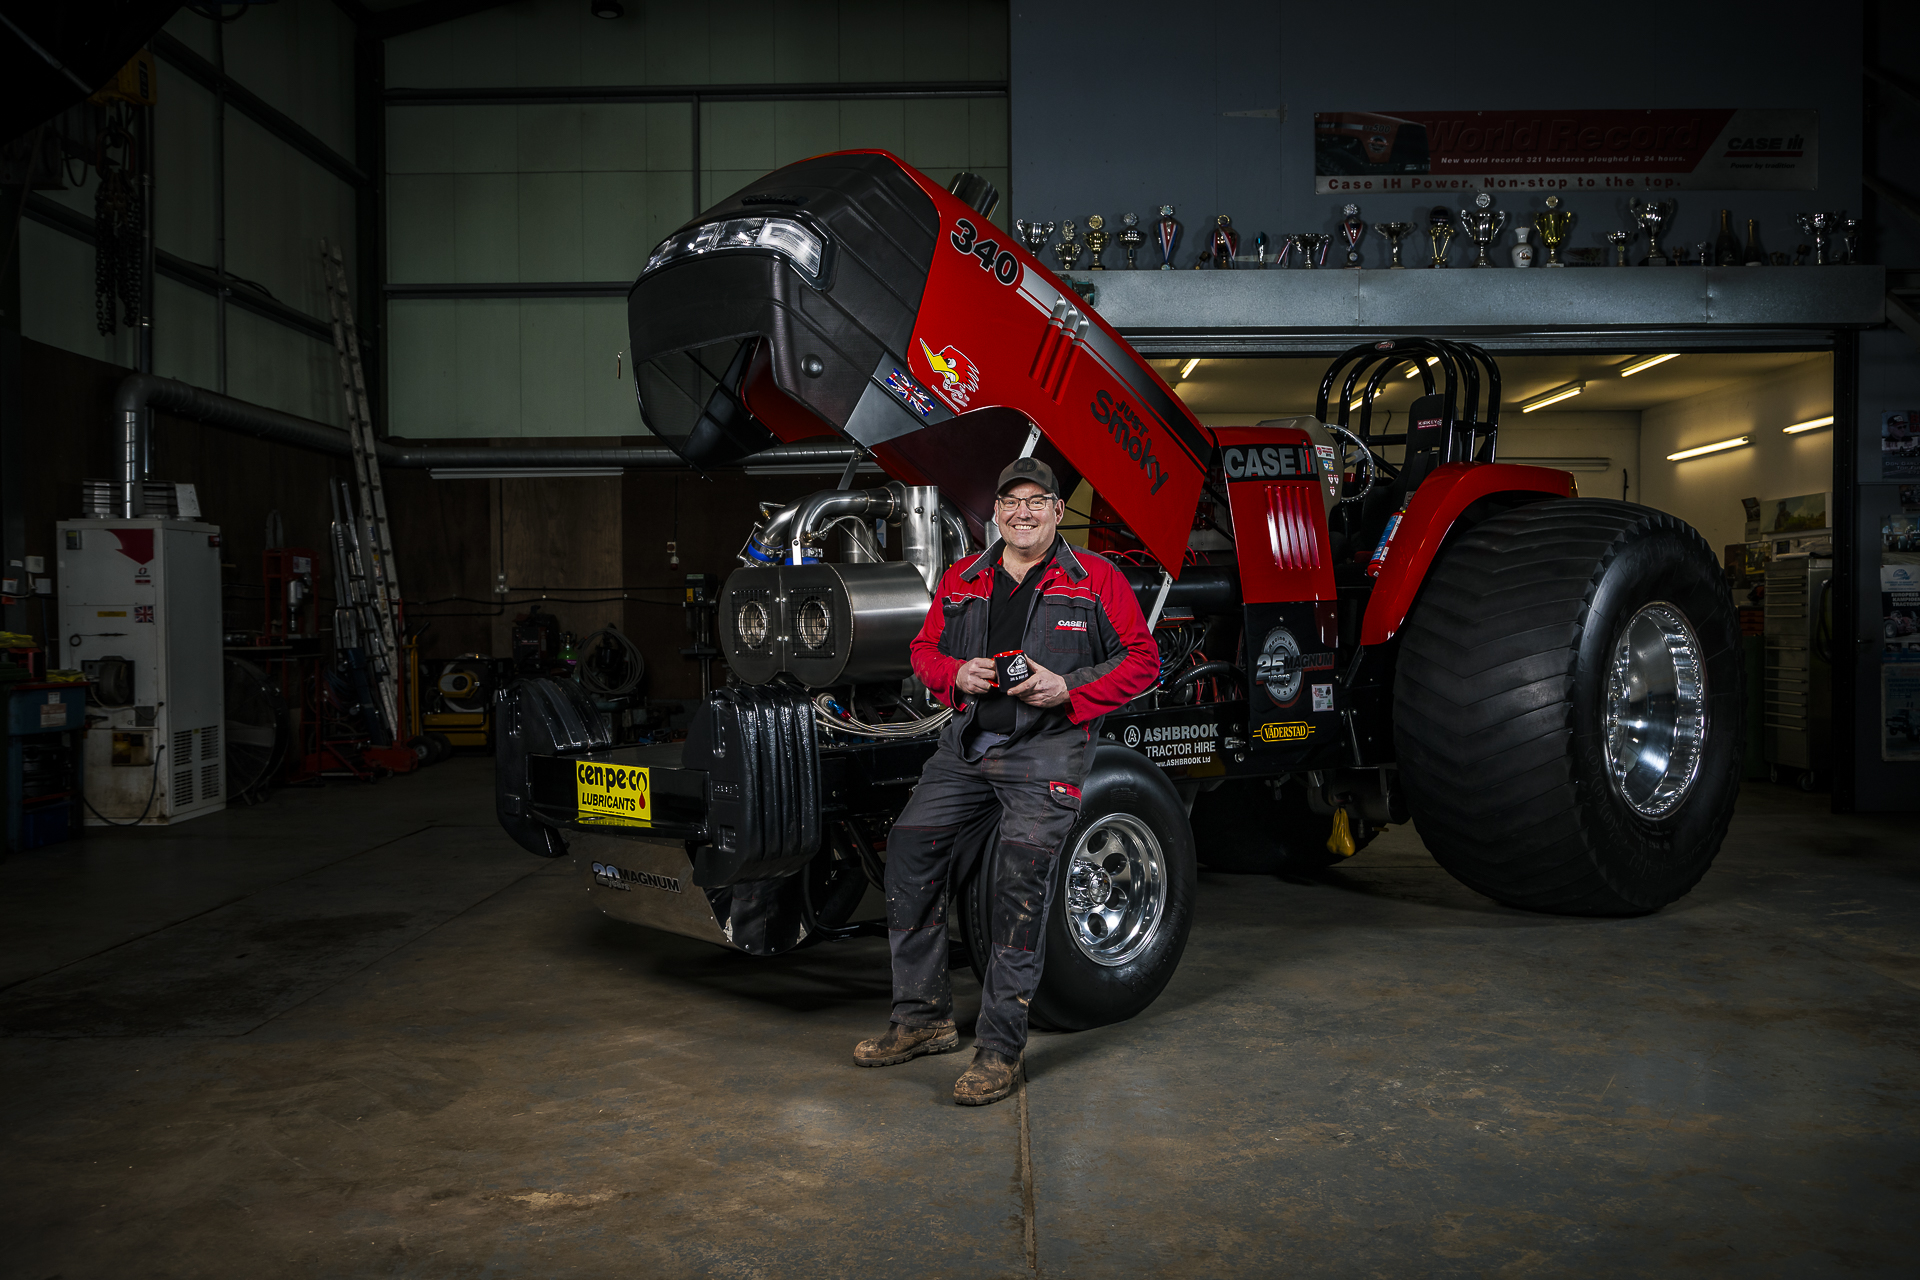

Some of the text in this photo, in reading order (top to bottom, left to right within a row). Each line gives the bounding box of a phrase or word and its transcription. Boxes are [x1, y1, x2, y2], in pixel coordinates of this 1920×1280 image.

[1423, 118, 1701, 153] World Record
[1727, 137, 1782, 150] CASE
[1491, 156, 1523, 164] record:
[1545, 155, 1586, 163] hectares
[1588, 155, 1630, 163] ploughed
[1755, 163, 1763, 171] by
[1328, 176, 1682, 190] Case IH Power. Non-stop to the top.
[950, 217, 1019, 286] 340
[1116, 400, 1149, 437] JUST
[1090, 389, 1169, 496] Smoky
[1224, 446, 1297, 479] CASE
[1057, 619, 1082, 628] CASE
[1256, 652, 1334, 682] 25 MAGNUM
[1268, 673, 1291, 687] years
[1143, 723, 1219, 742] ASHBROOK
[1145, 740, 1216, 758] TRACTOR HIRE
[582, 792, 636, 812] LUBRICANTS
[592, 861, 682, 894] 20 MAGNUM
